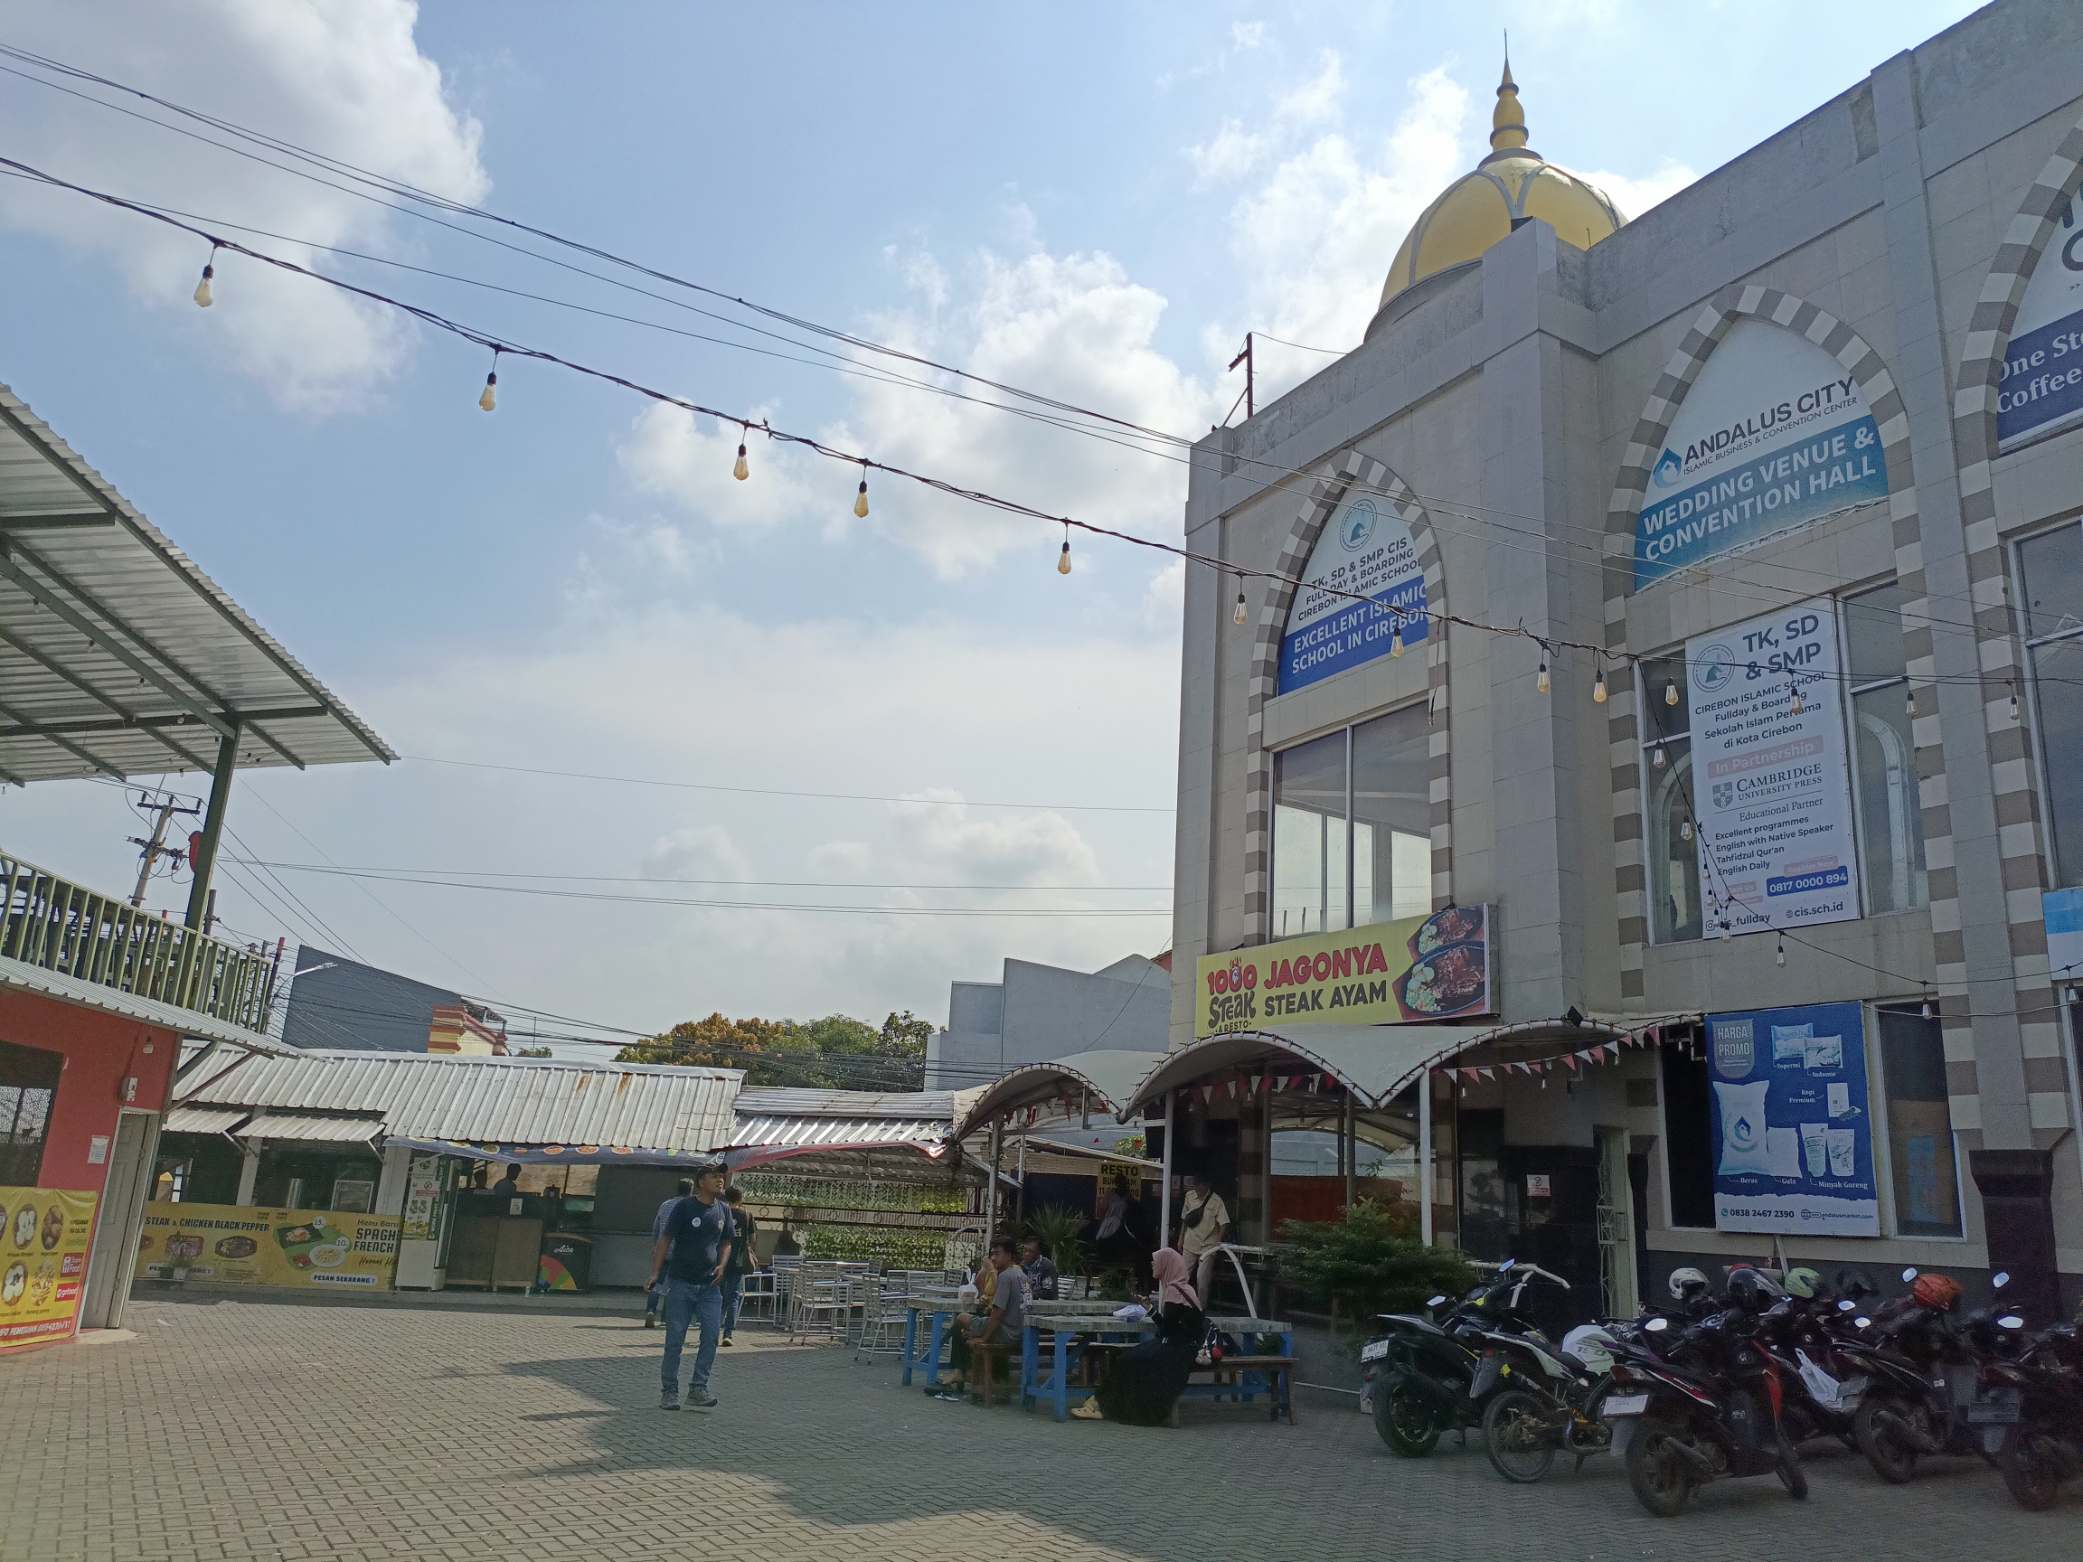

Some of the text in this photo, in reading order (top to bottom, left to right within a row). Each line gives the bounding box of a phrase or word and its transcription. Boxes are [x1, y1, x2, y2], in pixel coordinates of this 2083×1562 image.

[2052, 332, 2083, 359] St
[1998, 368, 2082, 413] Coffee
[1684, 375, 1854, 465] ANDALUS CITY
[1683, 396, 1857, 476] ISLAMIC BUSINESS & CONVENTION CENTER
[1643, 426, 1875, 535] WEDDING VENUE &
[1646, 455, 1876, 561] CONVENTION HALL
[1331, 566, 1346, 581] SD
[1349, 561, 1357, 573] &
[1360, 548, 1384, 568] SMP
[1387, 537, 1407, 554] CIS
[1351, 574, 1357, 583] &
[1360, 548, 1414, 579] BOARDING
[1298, 596, 1337, 621] CIREBON
[1381, 560, 1421, 584] SCHOOL
[1293, 583, 1426, 654] EXCELLENT ISLAMIC
[1743, 615, 1819, 653] TK, SD
[1292, 639, 1345, 674] SCHOOL
[1348, 631, 1361, 650] IN
[1746, 661, 1762, 681] &
[1768, 642, 1822, 675] SMP
[1695, 672, 1825, 715] CIREBON ISLAMIC SCHOOL
[1704, 723, 1743, 740] Sekolah
[1746, 715, 1774, 729] Islam
[1715, 707, 1750, 723] Fullday
[1752, 704, 1759, 712] &
[1724, 722, 1802, 750] di Kota Cirebon
[1714, 743, 1814, 775] In Partnership
[1738, 775, 1822, 802] UNIVERSITY PRESS
[1739, 798, 1823, 822] Educational Partner
[1715, 816, 1809, 841] Excellent programmes
[1715, 823, 1834, 853] English with Native Speaker
[1718, 860, 1770, 876] English Daily
[1770, 881, 1793, 893] 0817
[1796, 876, 1823, 888] 0000
[1794, 901, 1843, 917] cis.sch.id
[1207, 943, 1388, 996] 1000 JAGONYA
[1264, 988, 1324, 1017] STEAK
[1330, 980, 1387, 1008] AYAM
[1717, 1025, 1748, 1041] HARGA
[1718, 1043, 1750, 1058] PROMO
[1101, 1164, 1138, 1177] RESTO
[179, 1217, 214, 1230] CHICKEN
[215, 1219, 241, 1231] BLACK
[241, 1221, 271, 1233] PEPPER
[1730, 1208, 1750, 1217] 0838
[1752, 1209, 1771, 1218] 2467
[1774, 1209, 1795, 1219] 2390
[354, 1240, 394, 1253] FRENCH
